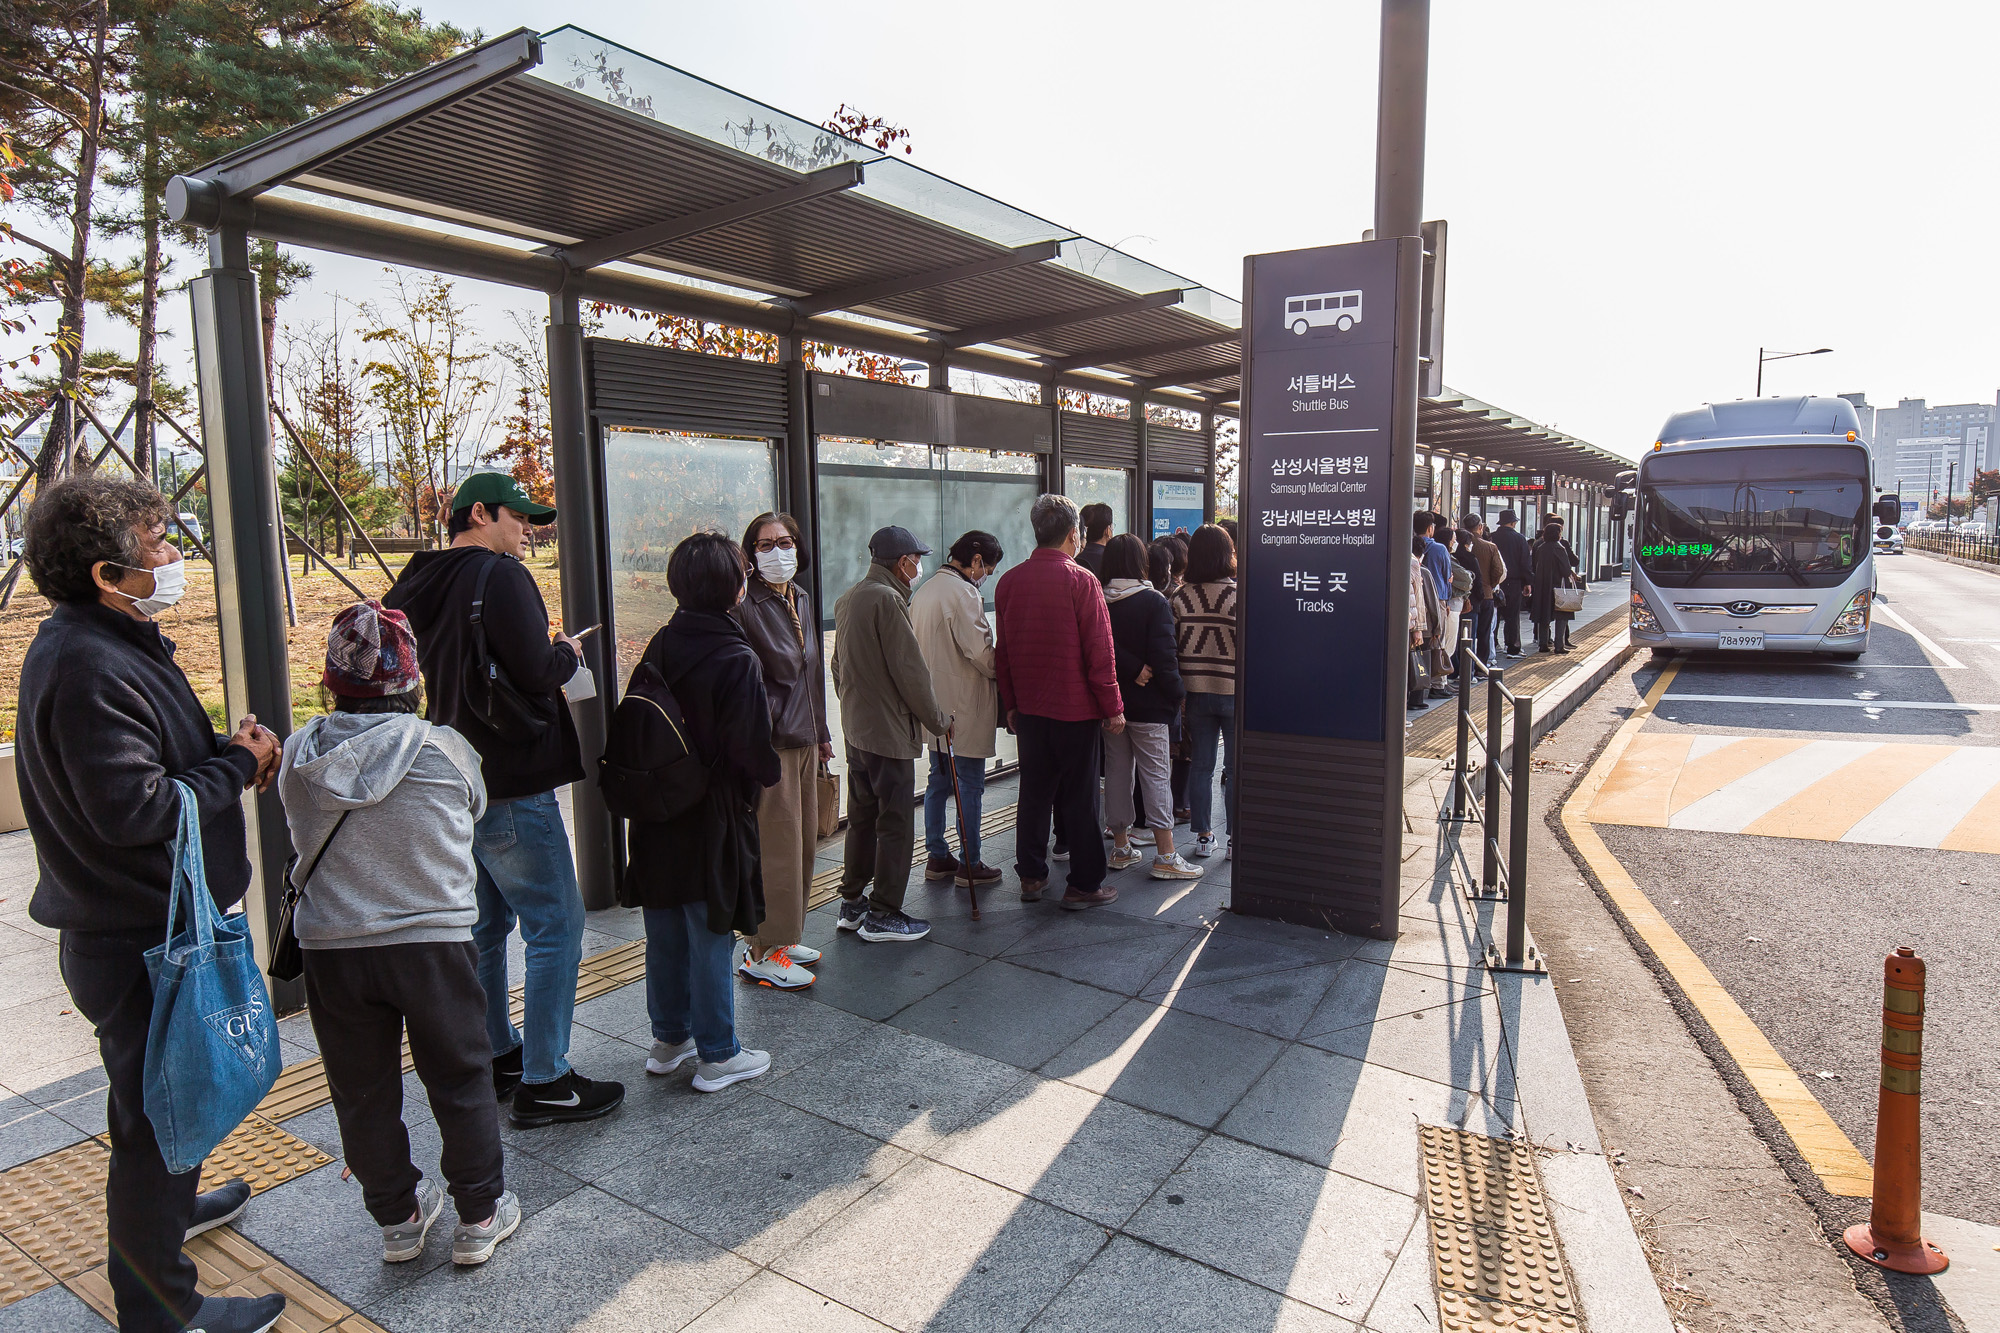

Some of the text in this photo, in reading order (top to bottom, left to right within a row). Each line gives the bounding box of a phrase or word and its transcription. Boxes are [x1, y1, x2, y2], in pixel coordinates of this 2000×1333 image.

[1286, 372, 1356, 394] 셔틀버스
[1292, 398, 1349, 412] Shuttle Bus
[1270, 455, 1369, 476] 삼성서울병원
[1270, 482, 1367, 496] Samsung Medical Center
[1261, 508, 1376, 527] 강남세브란스병원
[1261, 533, 1375, 547] Gangnam Severance Hospital
[1640, 543, 1713, 557] 삼성서울병원
[1282, 571, 1349, 592] 타는 곳
[1294, 598, 1334, 612] Tracks
